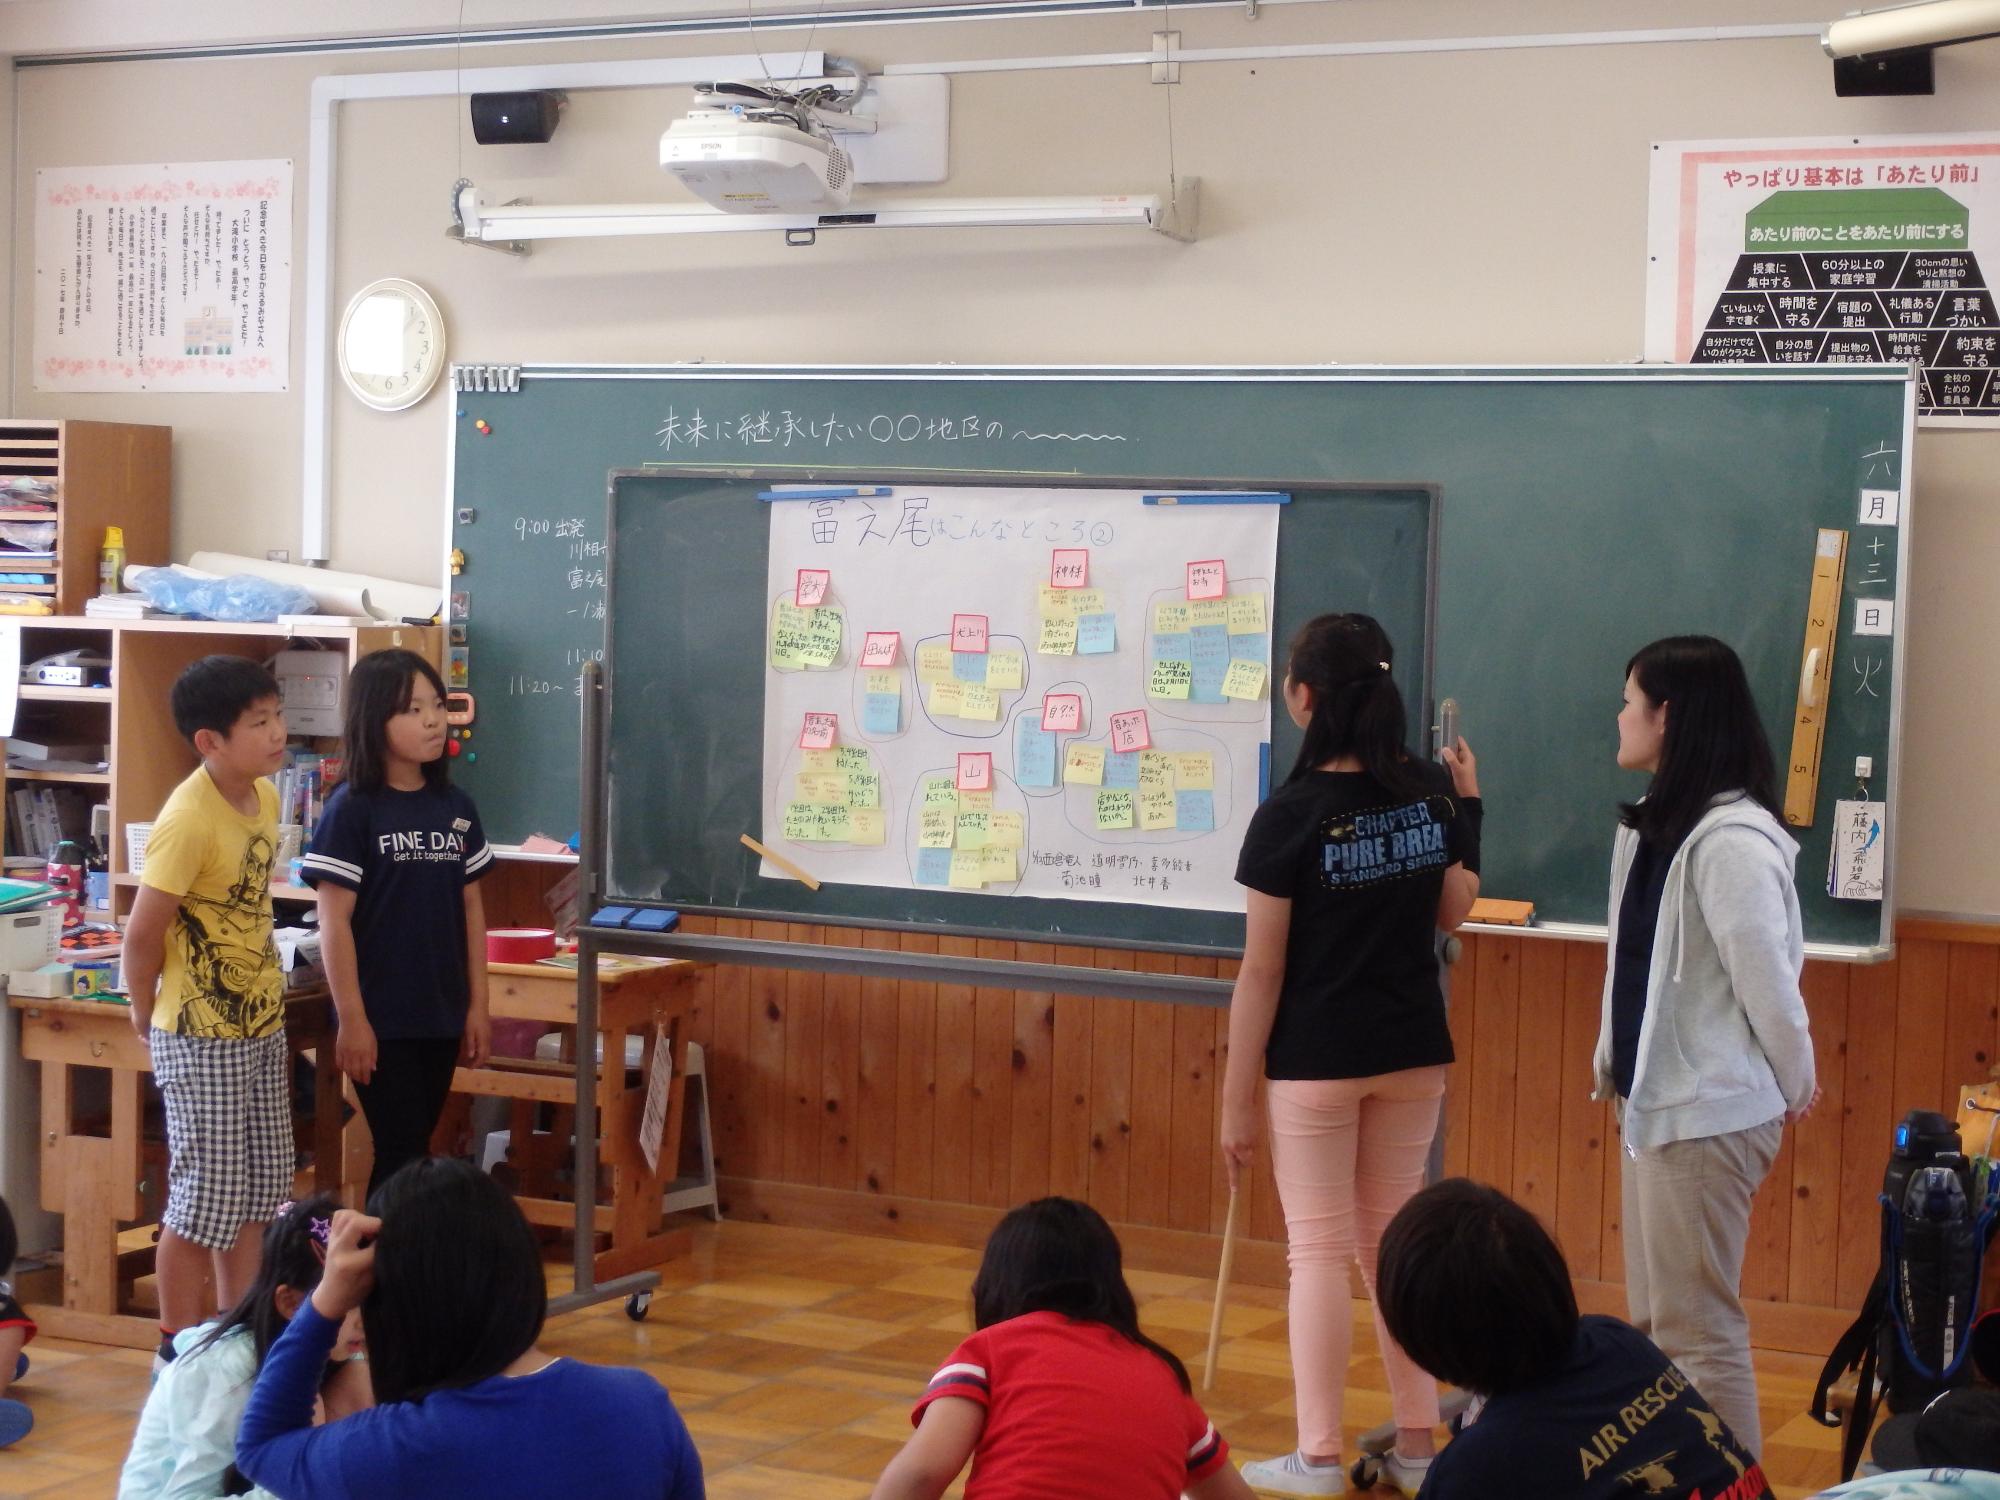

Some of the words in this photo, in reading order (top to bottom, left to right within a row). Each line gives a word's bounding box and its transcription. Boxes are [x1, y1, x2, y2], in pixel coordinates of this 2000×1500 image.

[1750, 224, 1965, 242] あたり前のことをあたり前にする
[1753, 263, 1787, 274] 授業に
[1822, 259, 1885, 270] 60分以上の
[1915, 258, 1968, 267] 30cmの思い
[1747, 276, 1791, 288] 集中する
[1829, 272, 1877, 285] 家庭学習
[1721, 304, 1766, 314] ていねいな
[1779, 297, 1818, 310] 時間を
[1837, 301, 1873, 313] 宿題の
[1889, 297, 1934, 310] 礼儀ある
[1953, 297, 1981, 311] 言葉
[1726, 316, 1759, 325] 字で書く
[1785, 313, 1810, 326] 守る
[1843, 316, 1866, 327] 提出
[1900, 312, 1923, 323] 行動
[1946, 316, 1987, 328] づかい
[1706, 338, 1754, 347] 自分だけでな
[1888, 332, 1927, 342] 時間内に
[1775, 340, 1813, 350] 自分の思
[1831, 342, 1870, 353] 提出物の
[1956, 336, 1996, 351] 約束を
[1702, 348, 1756, 358] いのがクラスと
[1893, 345, 1922, 355] 給食を
[1775, 352, 1812, 362] いを話す
[1963, 354, 1990, 367] 守る
[1944, 384, 1971, 393] ための
[515, 517, 549, 540] 9:00
[555, 518, 586, 537] 出発
[1055, 565, 1083, 579] 神様
[1122, 730, 1135, 745] 店
[965, 763, 981, 778] 山
[1355, 801, 1432, 836] CHAPTER
[379, 831, 426, 854] FINE
[431, 831, 464, 852] DAY
[1325, 836, 1387, 872] PURE
[1391, 823, 1448, 859] BREA
[393, 852, 411, 862] Get
[413, 850, 423, 860] it
[425, 851, 461, 862] together
[1331, 862, 1402, 885] STANDARD
[1580, 1423, 1629, 1481] AIR
